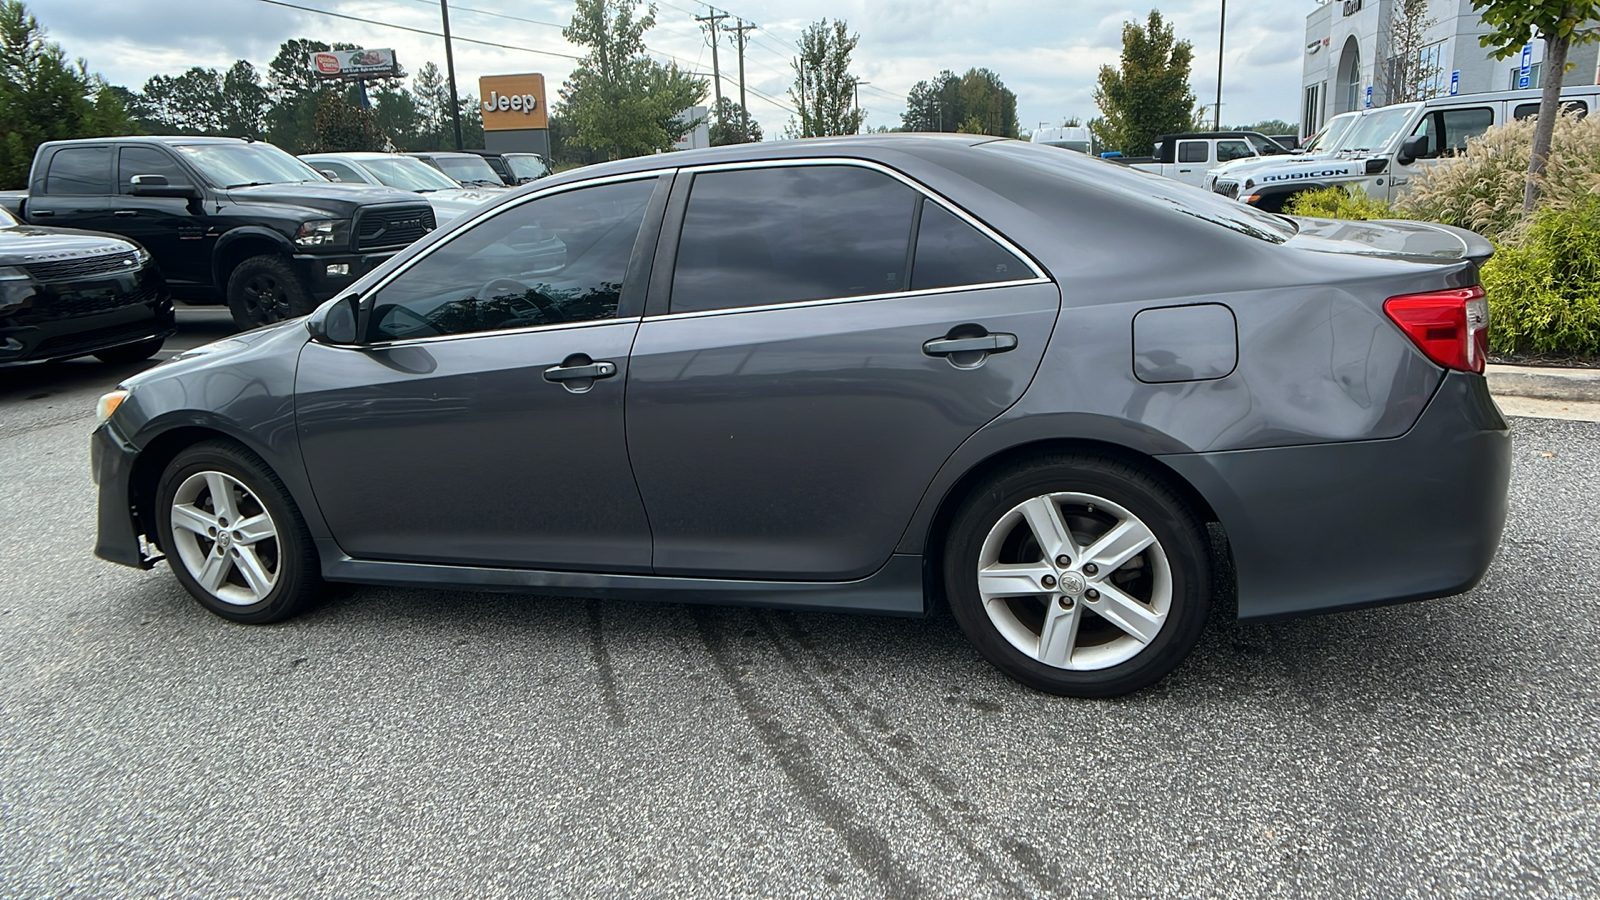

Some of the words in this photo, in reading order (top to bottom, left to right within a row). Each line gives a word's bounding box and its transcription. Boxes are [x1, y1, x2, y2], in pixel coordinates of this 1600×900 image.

[483, 91, 536, 114] Jeep
[1263, 168, 1349, 182] RUBICON
[389, 219, 421, 229] RAM
[84, 246, 124, 254] ROVER
